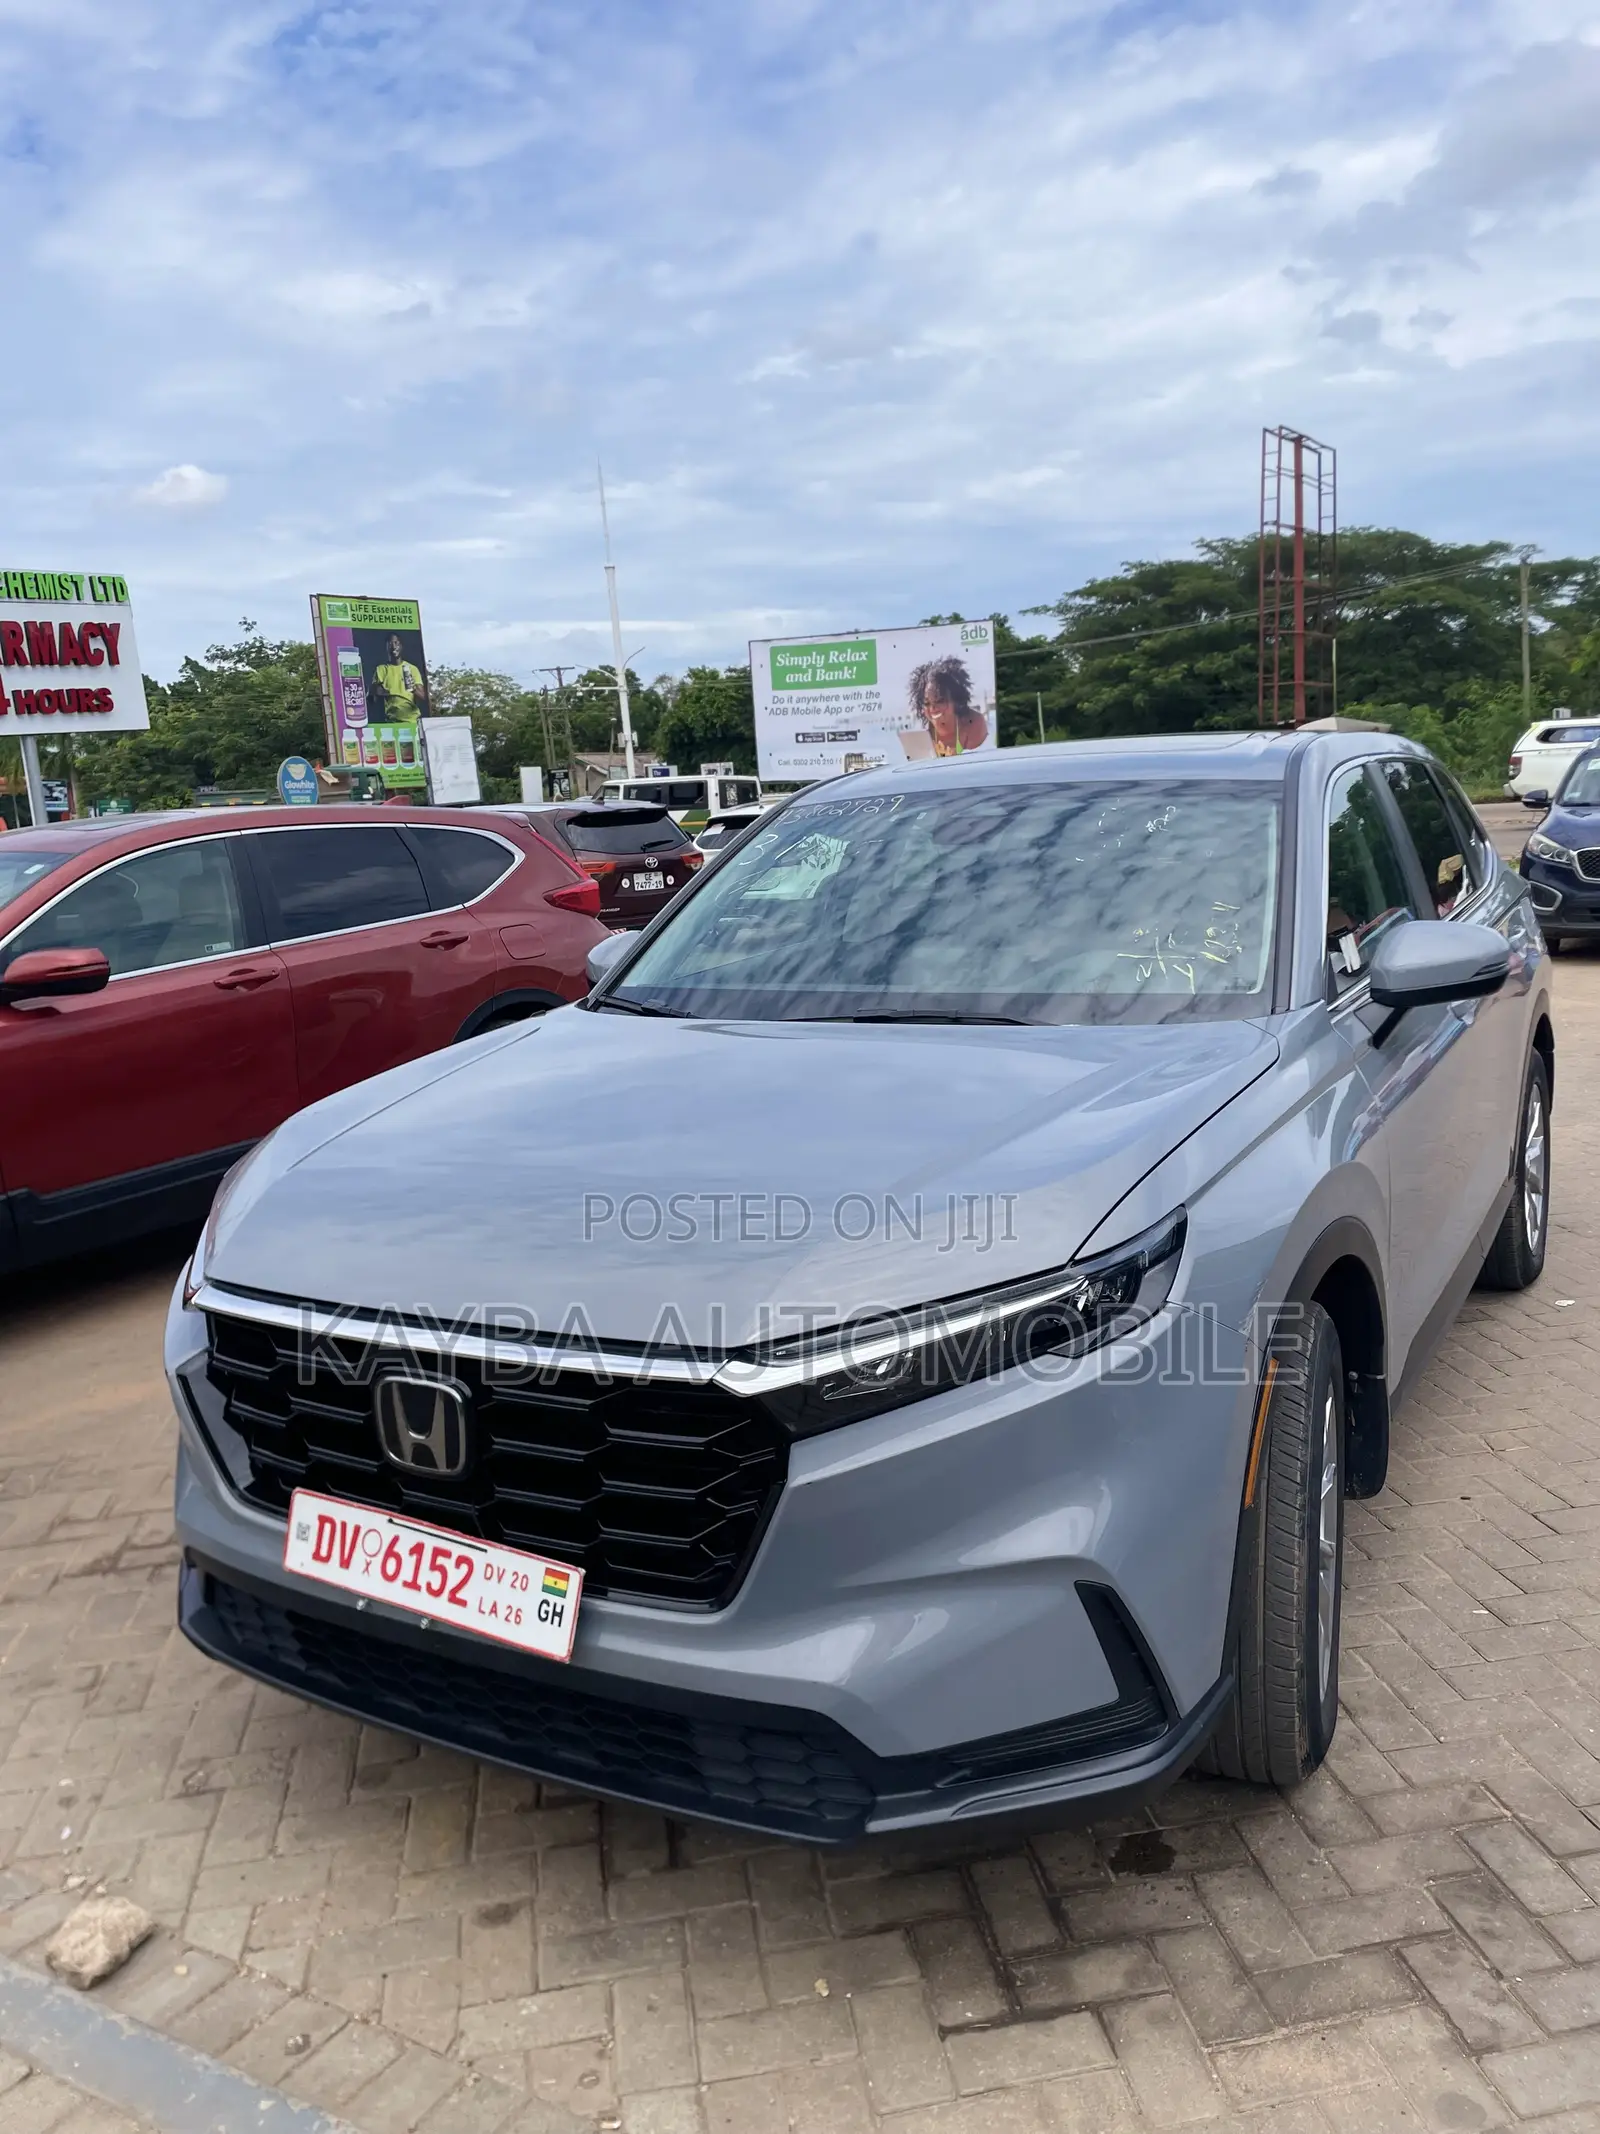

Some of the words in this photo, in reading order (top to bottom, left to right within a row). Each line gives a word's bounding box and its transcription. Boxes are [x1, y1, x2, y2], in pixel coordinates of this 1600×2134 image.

[89, 575, 129, 602] LTD
[350, 604, 369, 613] LIFE
[371, 605, 412, 615] Essentials
[351, 613, 413, 624] SUPPLEMENTS
[0, 620, 121, 667] RMACY
[776, 651, 825, 668] Simply
[828, 648, 868, 664] Relax
[785, 668, 813, 683] and
[816, 666, 857, 682] Bank!
[12, 687, 114, 715] HOURS
[768, 706, 789, 716] ADB
[791, 706, 821, 716] Mobile
[823, 705, 843, 717] App
[845, 705, 855, 713] or
[772, 695, 785, 705] Do
[787, 694, 793, 704] it
[795, 693, 840, 705] anywhere
[842, 691, 863, 701] with
[865, 690, 881, 700] the
[312, 1514, 361, 1570] DV
[380, 1534, 475, 1608] 6152
[483, 1563, 507, 1585] DV
[510, 1571, 529, 1592] 20
[477, 1596, 498, 1619] LA
[504, 1604, 523, 1626] 26
[537, 1599, 565, 1628] GH
